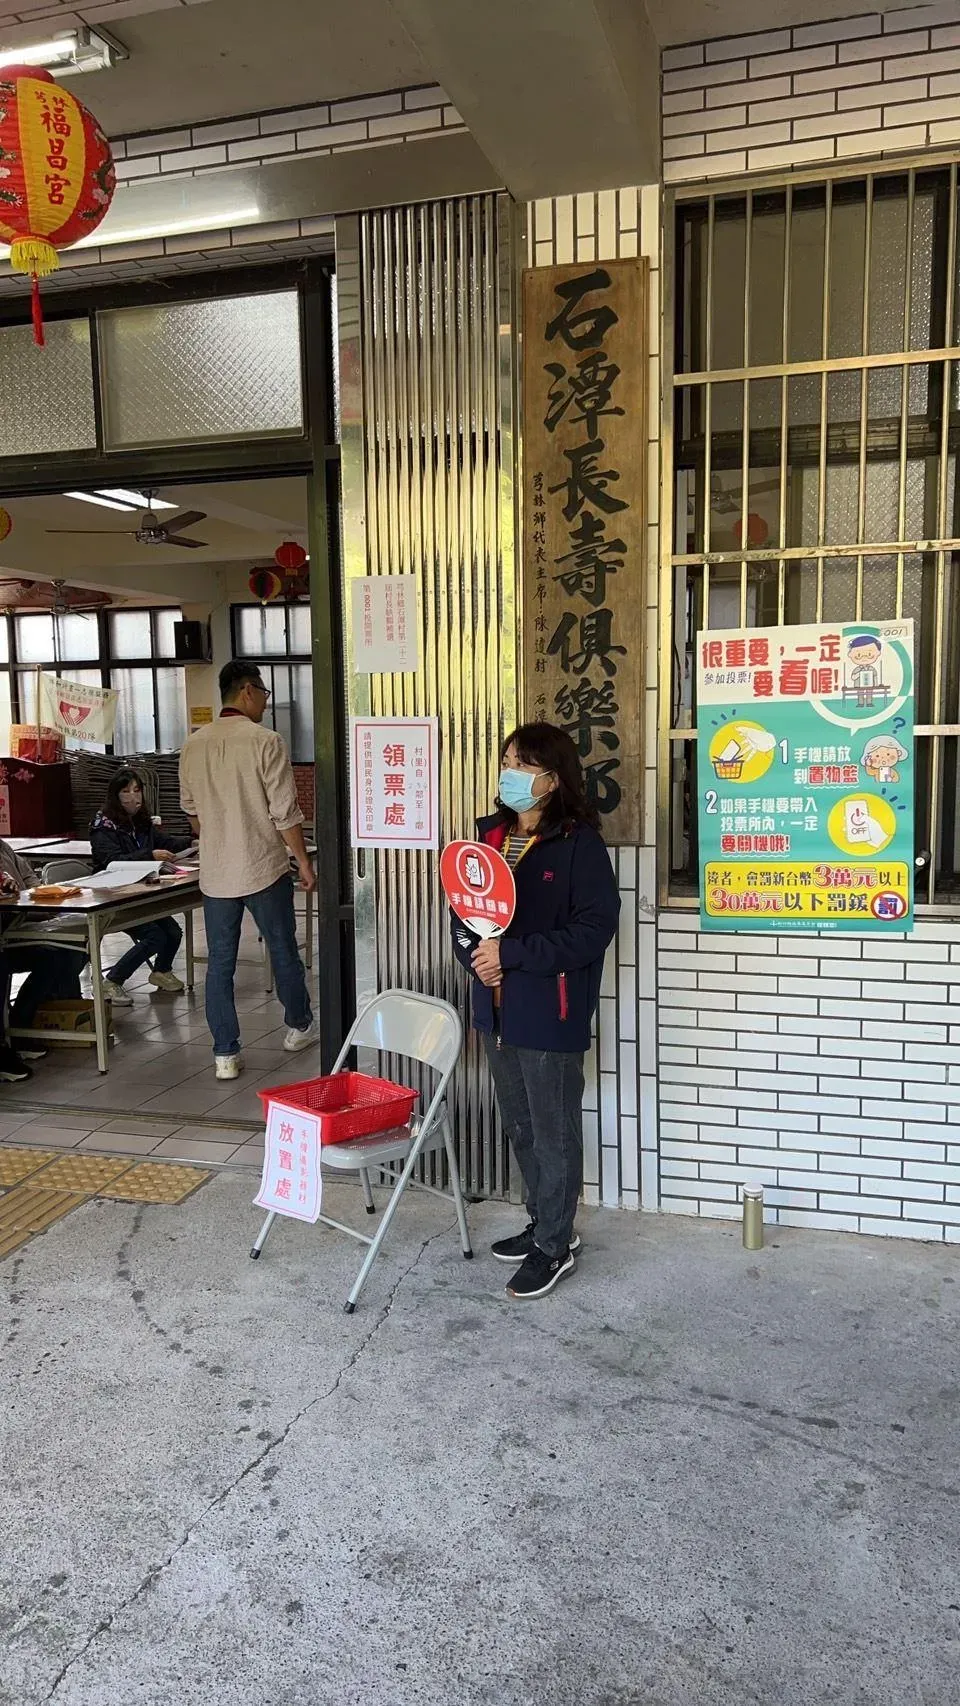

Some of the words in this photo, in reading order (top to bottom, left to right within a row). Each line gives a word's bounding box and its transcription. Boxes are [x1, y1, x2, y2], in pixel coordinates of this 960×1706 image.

[40, 105, 72, 205] 福昌宮
[778, 739, 789, 765] 1
[794, 745, 851, 763] 手機請放
[382, 743, 406, 826] 領票處
[793, 763, 859, 785] 到置物籃
[704, 790, 718, 814] 2
[720, 796, 818, 814] 如果手機要帶入
[850, 826, 867, 835] OFF
[274, 1121, 295, 1200] 放置處
